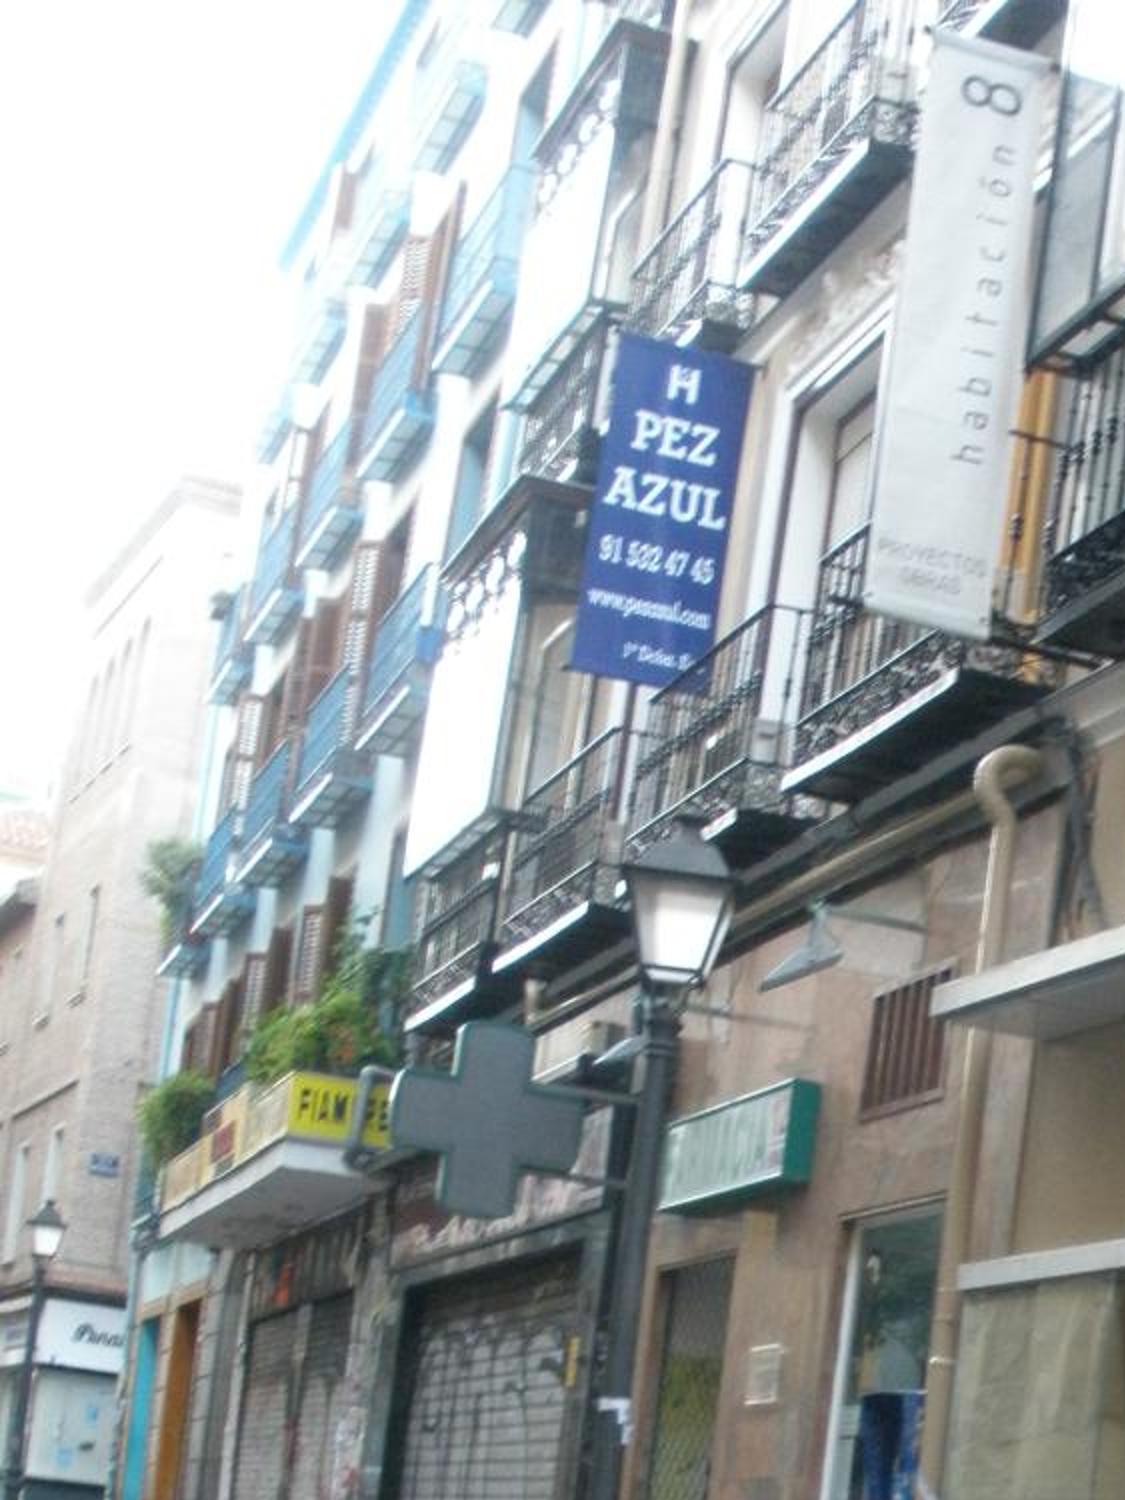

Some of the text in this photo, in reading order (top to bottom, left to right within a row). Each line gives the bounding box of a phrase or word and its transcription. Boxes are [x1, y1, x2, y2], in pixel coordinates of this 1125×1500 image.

[949, 73, 1021, 466] habitación 8
[630, 408, 720, 468] PEZ
[603, 465, 726, 530] AZUL
